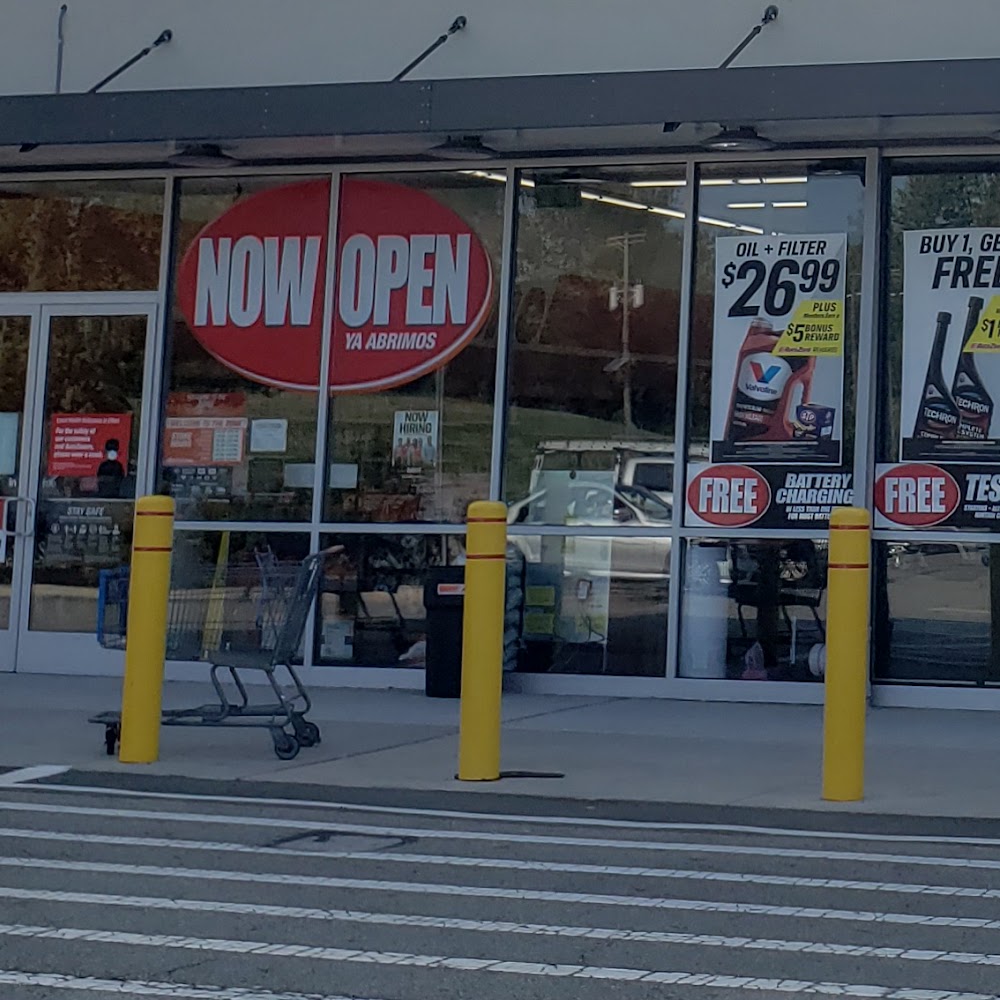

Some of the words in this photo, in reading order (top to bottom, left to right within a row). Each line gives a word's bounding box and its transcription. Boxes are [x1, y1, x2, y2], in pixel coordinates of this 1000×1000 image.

[736, 242, 759, 257] OIL
[778, 241, 827, 256] FILTER
[919, 234, 959, 254] BUY
[962, 233, 973, 255] 1,
[194, 235, 322, 327] NOW
[339, 233, 471, 328] OPEN
[813, 302, 837, 312] PLUS
[786, 322, 805, 342] $5
[804, 324, 833, 332] BONUS
[981, 318, 996, 339] $1
[345, 333, 362, 350] YA
[365, 332, 437, 349] ABRIMOS
[804, 333, 840, 341] REWARD
[745, 383, 778, 395] Valvoline
[956, 396, 990, 414] TECHRON
[405, 412, 428, 422] NOW
[924, 407, 958, 425] TECHRON
[400, 422, 432, 433] HIRING
[785, 473, 852, 489] BATTERY
[699, 477, 758, 514] FREE
[775, 488, 854, 504] CHARGING
[884, 477, 946, 514] FREE
